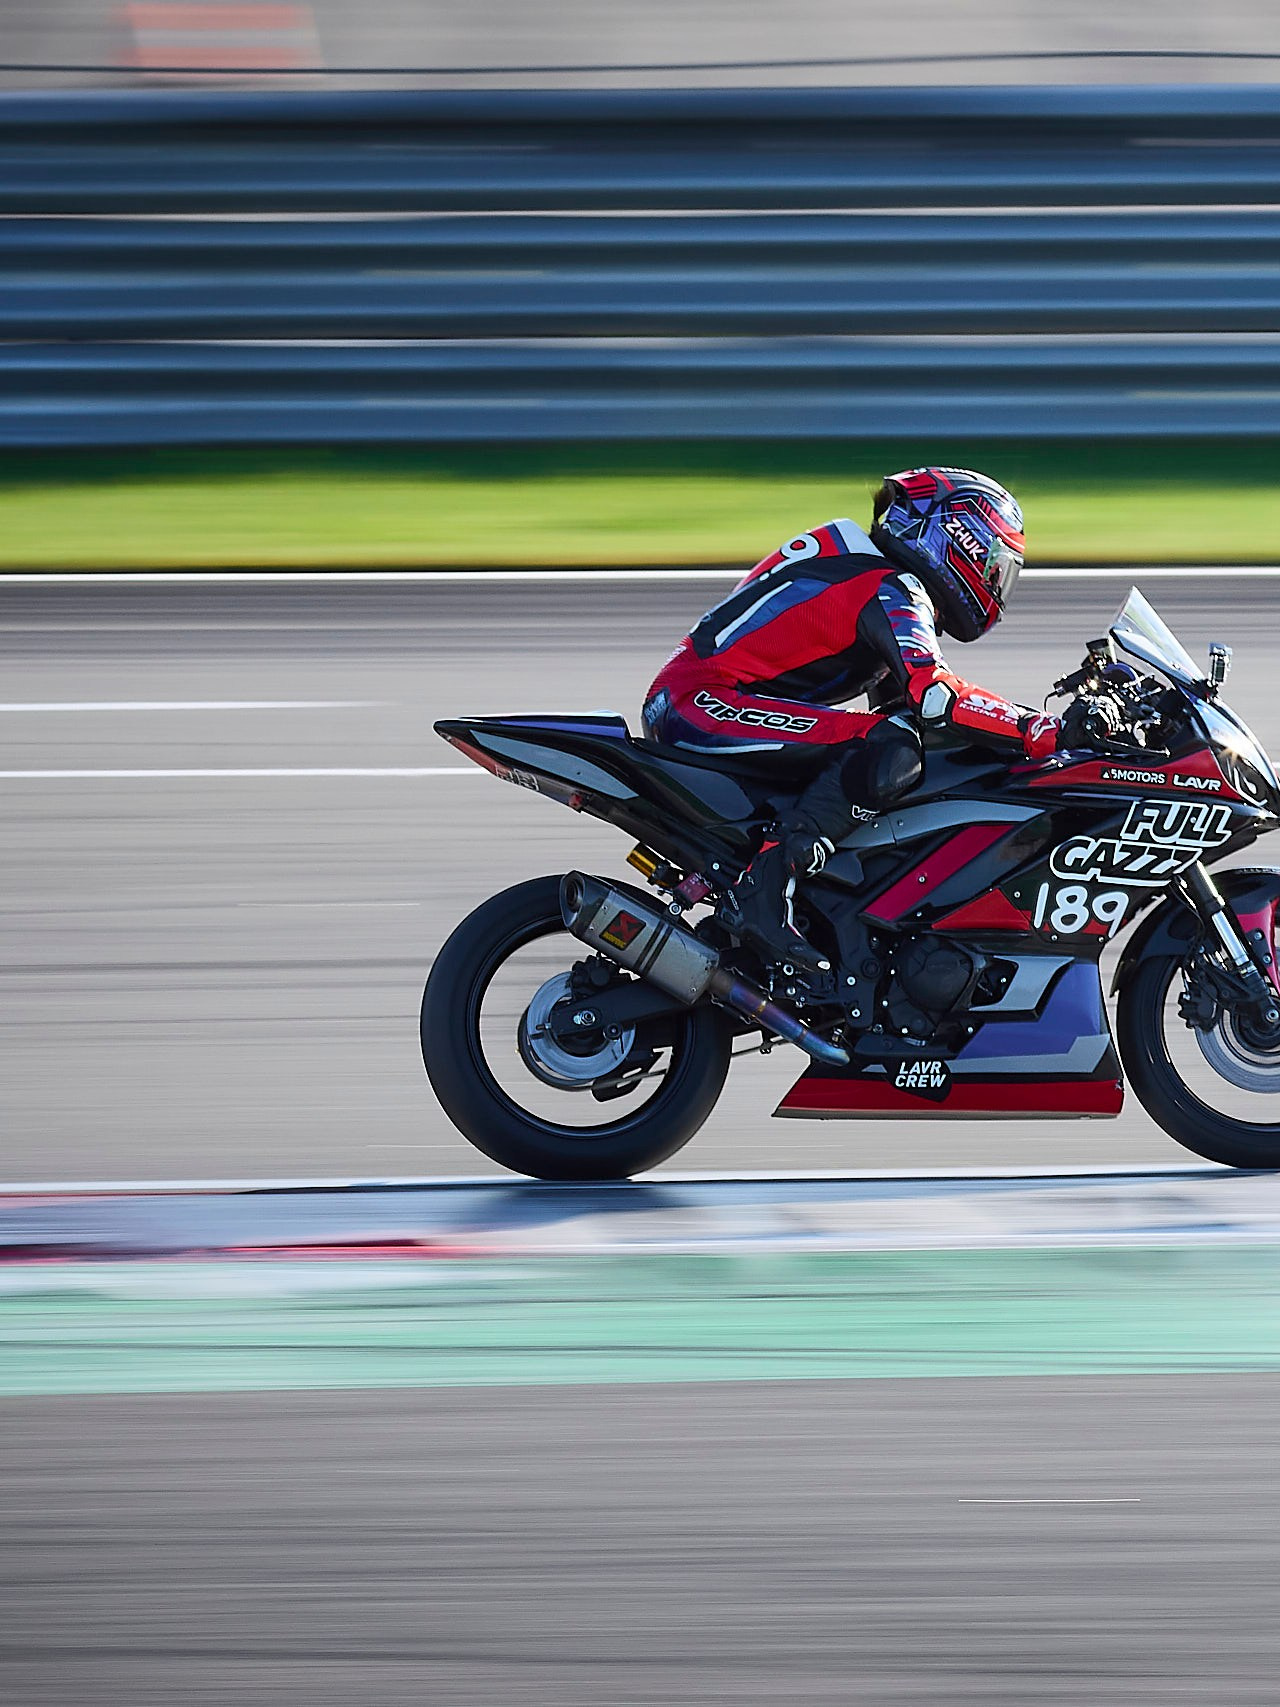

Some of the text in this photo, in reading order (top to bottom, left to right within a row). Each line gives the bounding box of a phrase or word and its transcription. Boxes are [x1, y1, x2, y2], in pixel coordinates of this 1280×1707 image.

[945, 516, 984, 560] ZHUK
[959, 703, 1018, 725] RACING TEA
[1173, 774, 1222, 791] LAVR
[1120, 800, 1233, 848] FULL
[1034, 882, 1129, 938] 189
[899, 1061, 942, 1074] LAVR
[895, 1074, 946, 1088] CREW
